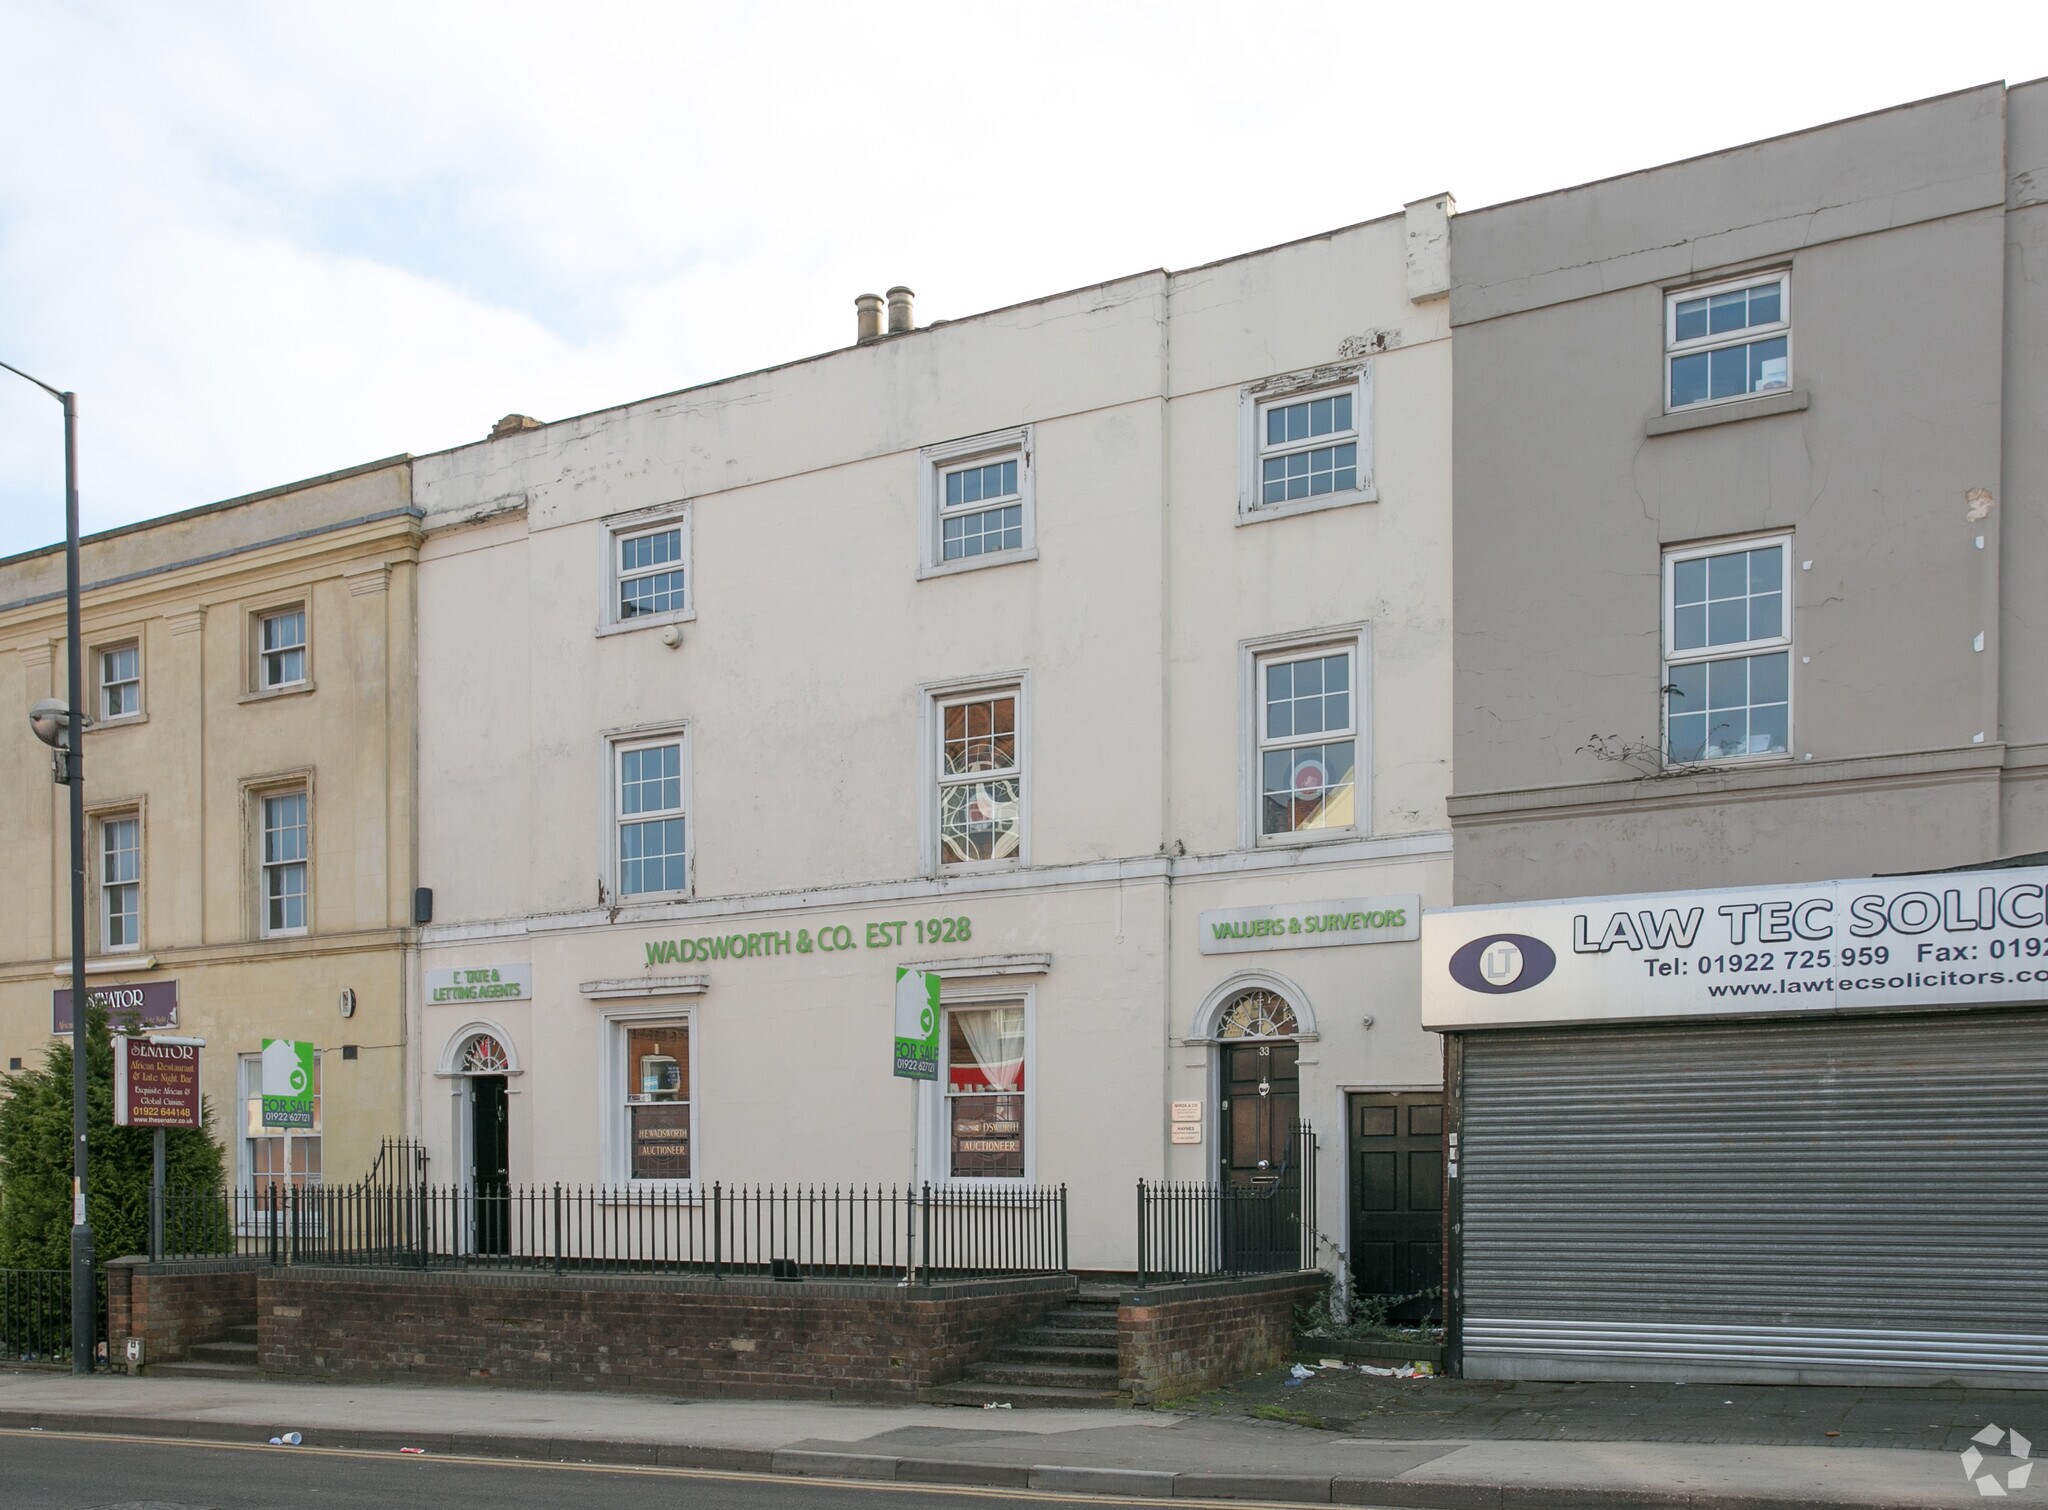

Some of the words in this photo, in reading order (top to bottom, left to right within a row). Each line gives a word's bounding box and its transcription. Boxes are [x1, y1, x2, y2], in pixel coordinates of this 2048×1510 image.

[1212, 919, 1285, 939] VALUERS
[1288, 917, 1301, 934] &
[1304, 909, 1406, 933] SURVEYORS
[1573, 907, 1704, 954] LAW
[1718, 899, 1833, 945] TEC
[1849, 884, 2048, 937] SOLIC
[645, 930, 791, 965] WADSWORTH
[796, 929, 813, 953] &
[817, 925, 857, 951] CO.
[866, 920, 907, 948] EST
[914, 916, 972, 944] 1928
[1488, 948, 1517, 978] LT
[1644, 957, 1688, 977] Tel:
[1698, 952, 1775, 974] 01922
[1784, 950, 1831, 970] 725
[1841, 946, 1889, 967] 959
[1917, 942, 1978, 963] Fax:
[464, 969, 490, 983] TATE
[491, 968, 500, 982] &
[433, 986, 477, 1001] LETTING
[478, 983, 521, 998] AGENTS
[131, 1042, 193, 1059] SENATOR
[895, 1041, 917, 1059] FOR
[919, 1044, 938, 1061] SALE
[1259, 1046, 1270, 1056] 33
[130, 1060, 154, 1070] African
[156, 1062, 194, 1072] Restaurant
[897, 1058, 917, 1071] 01922
[133, 1072, 140, 1080] &
[143, 1072, 158, 1082] Late
[161, 1073, 177, 1085] Night
[180, 1074, 192, 1083] Bar
[163, 1087, 182, 1095] African
[140, 1097, 161, 1105] Global
[163, 1098, 185, 1106] Cuisine
[262, 1098, 287, 1112] FOR
[289, 1099, 314, 1112] SALE
[133, 1106, 158, 1116] 01922
[160, 1107, 191, 1117] 644148
[265, 1112, 288, 1121] 01922
[642, 1145, 685, 1155] AUCTIONEER
[964, 1141, 1016, 1151] AUCTIONEER
